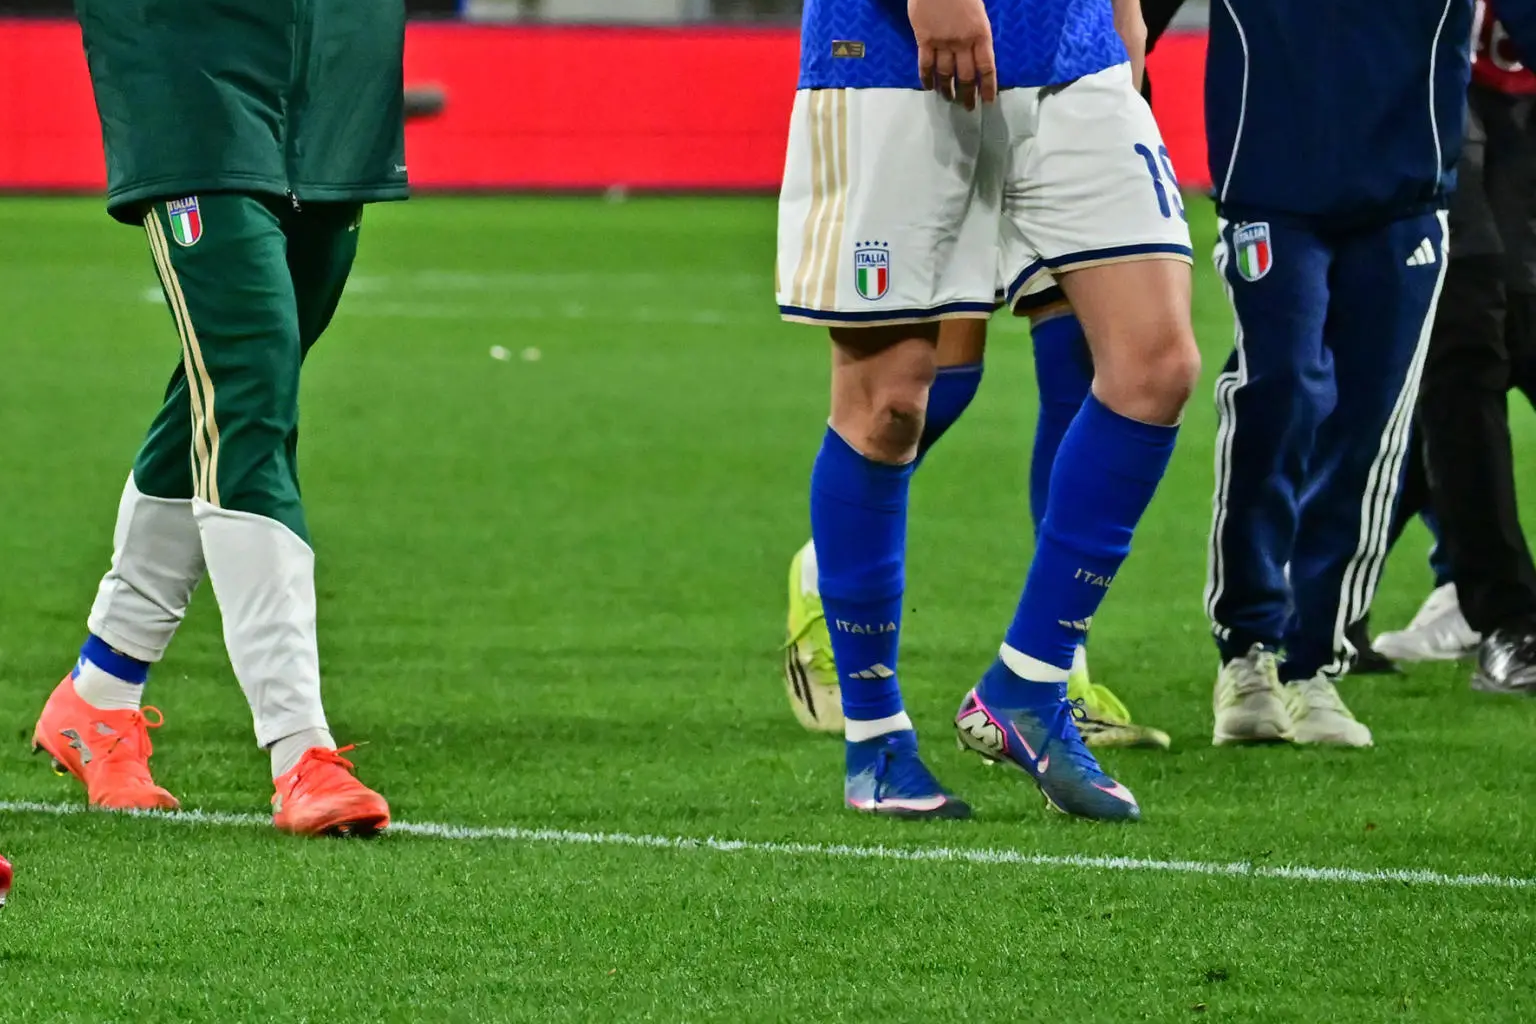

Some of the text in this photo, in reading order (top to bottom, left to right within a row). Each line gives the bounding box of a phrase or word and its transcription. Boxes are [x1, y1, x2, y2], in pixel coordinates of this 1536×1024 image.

[167, 195, 196, 213] ITALIA
[857, 253, 887, 263] ITALIA
[835, 618, 897, 635] ITALIA
